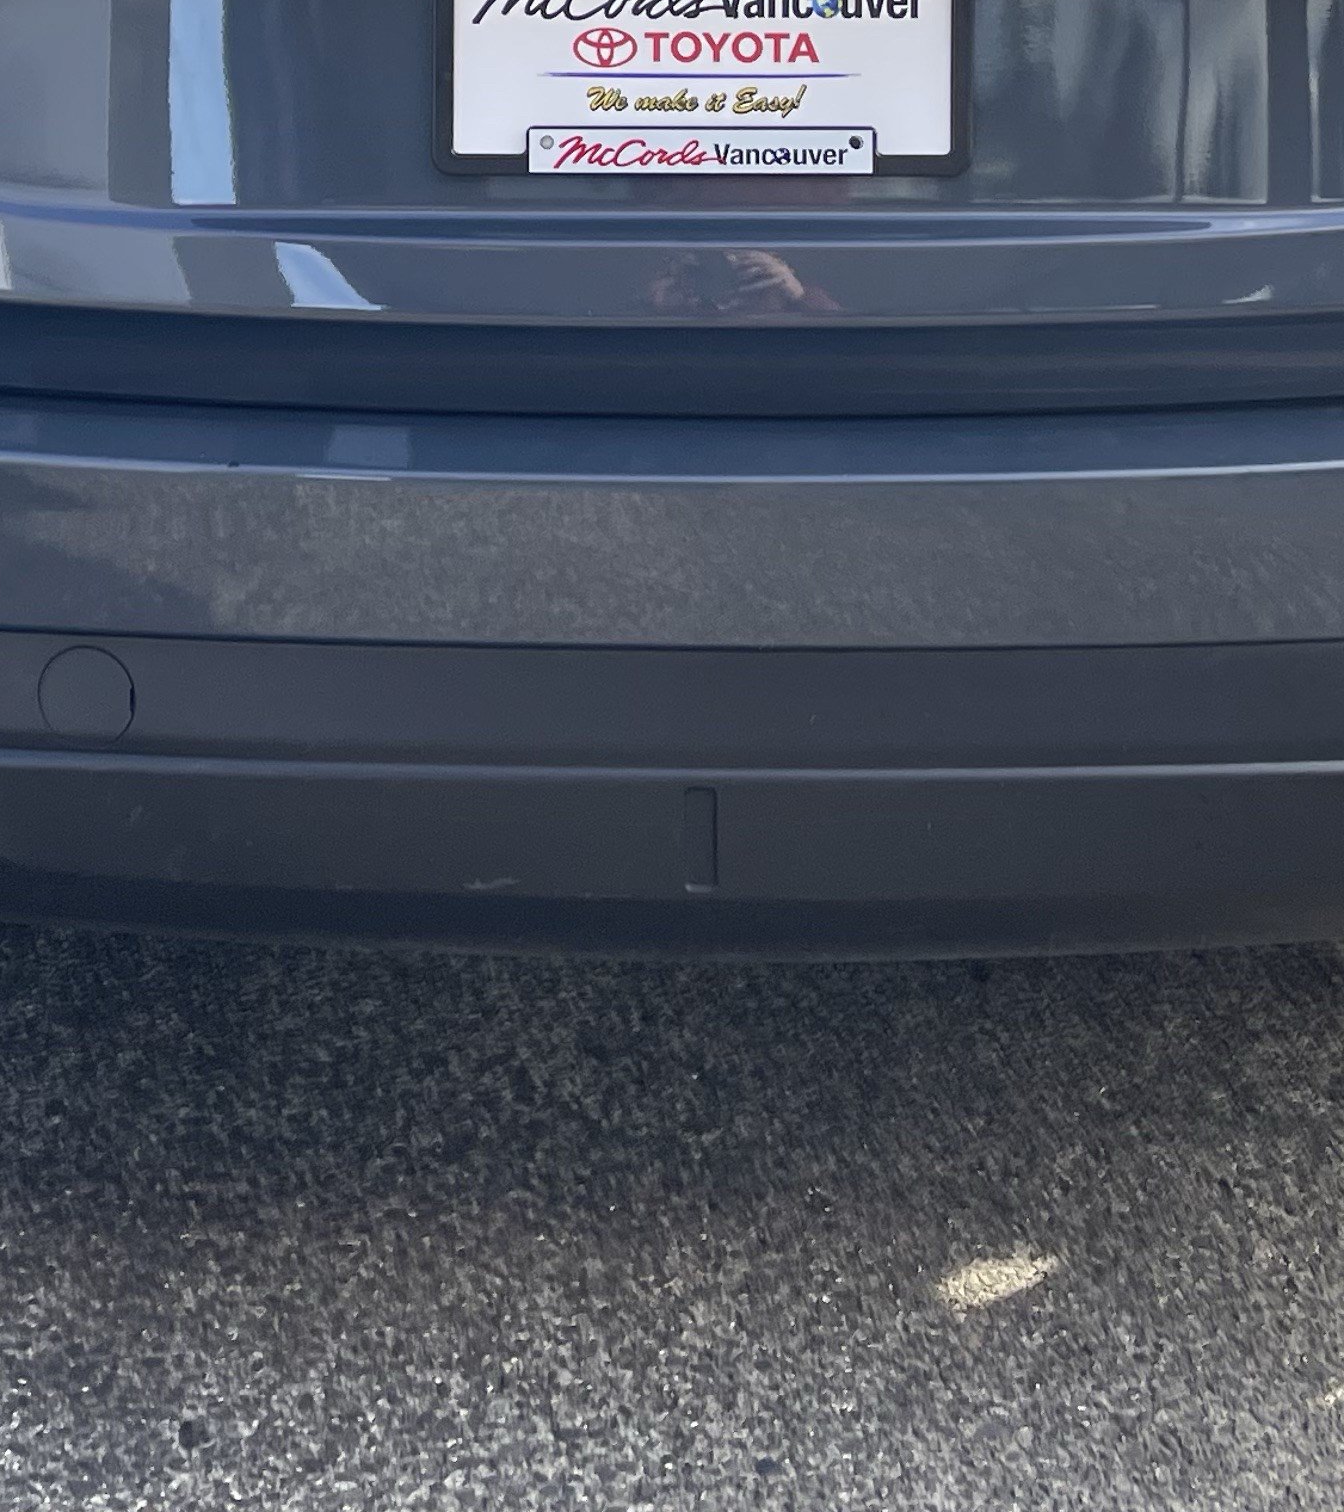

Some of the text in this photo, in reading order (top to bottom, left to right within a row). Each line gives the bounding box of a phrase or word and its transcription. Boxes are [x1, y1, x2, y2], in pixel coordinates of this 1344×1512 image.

[643, 30, 820, 64] TOYOTA
[586, 84, 807, 119] We make it Easy!
[553, 135, 713, 170] McCords
